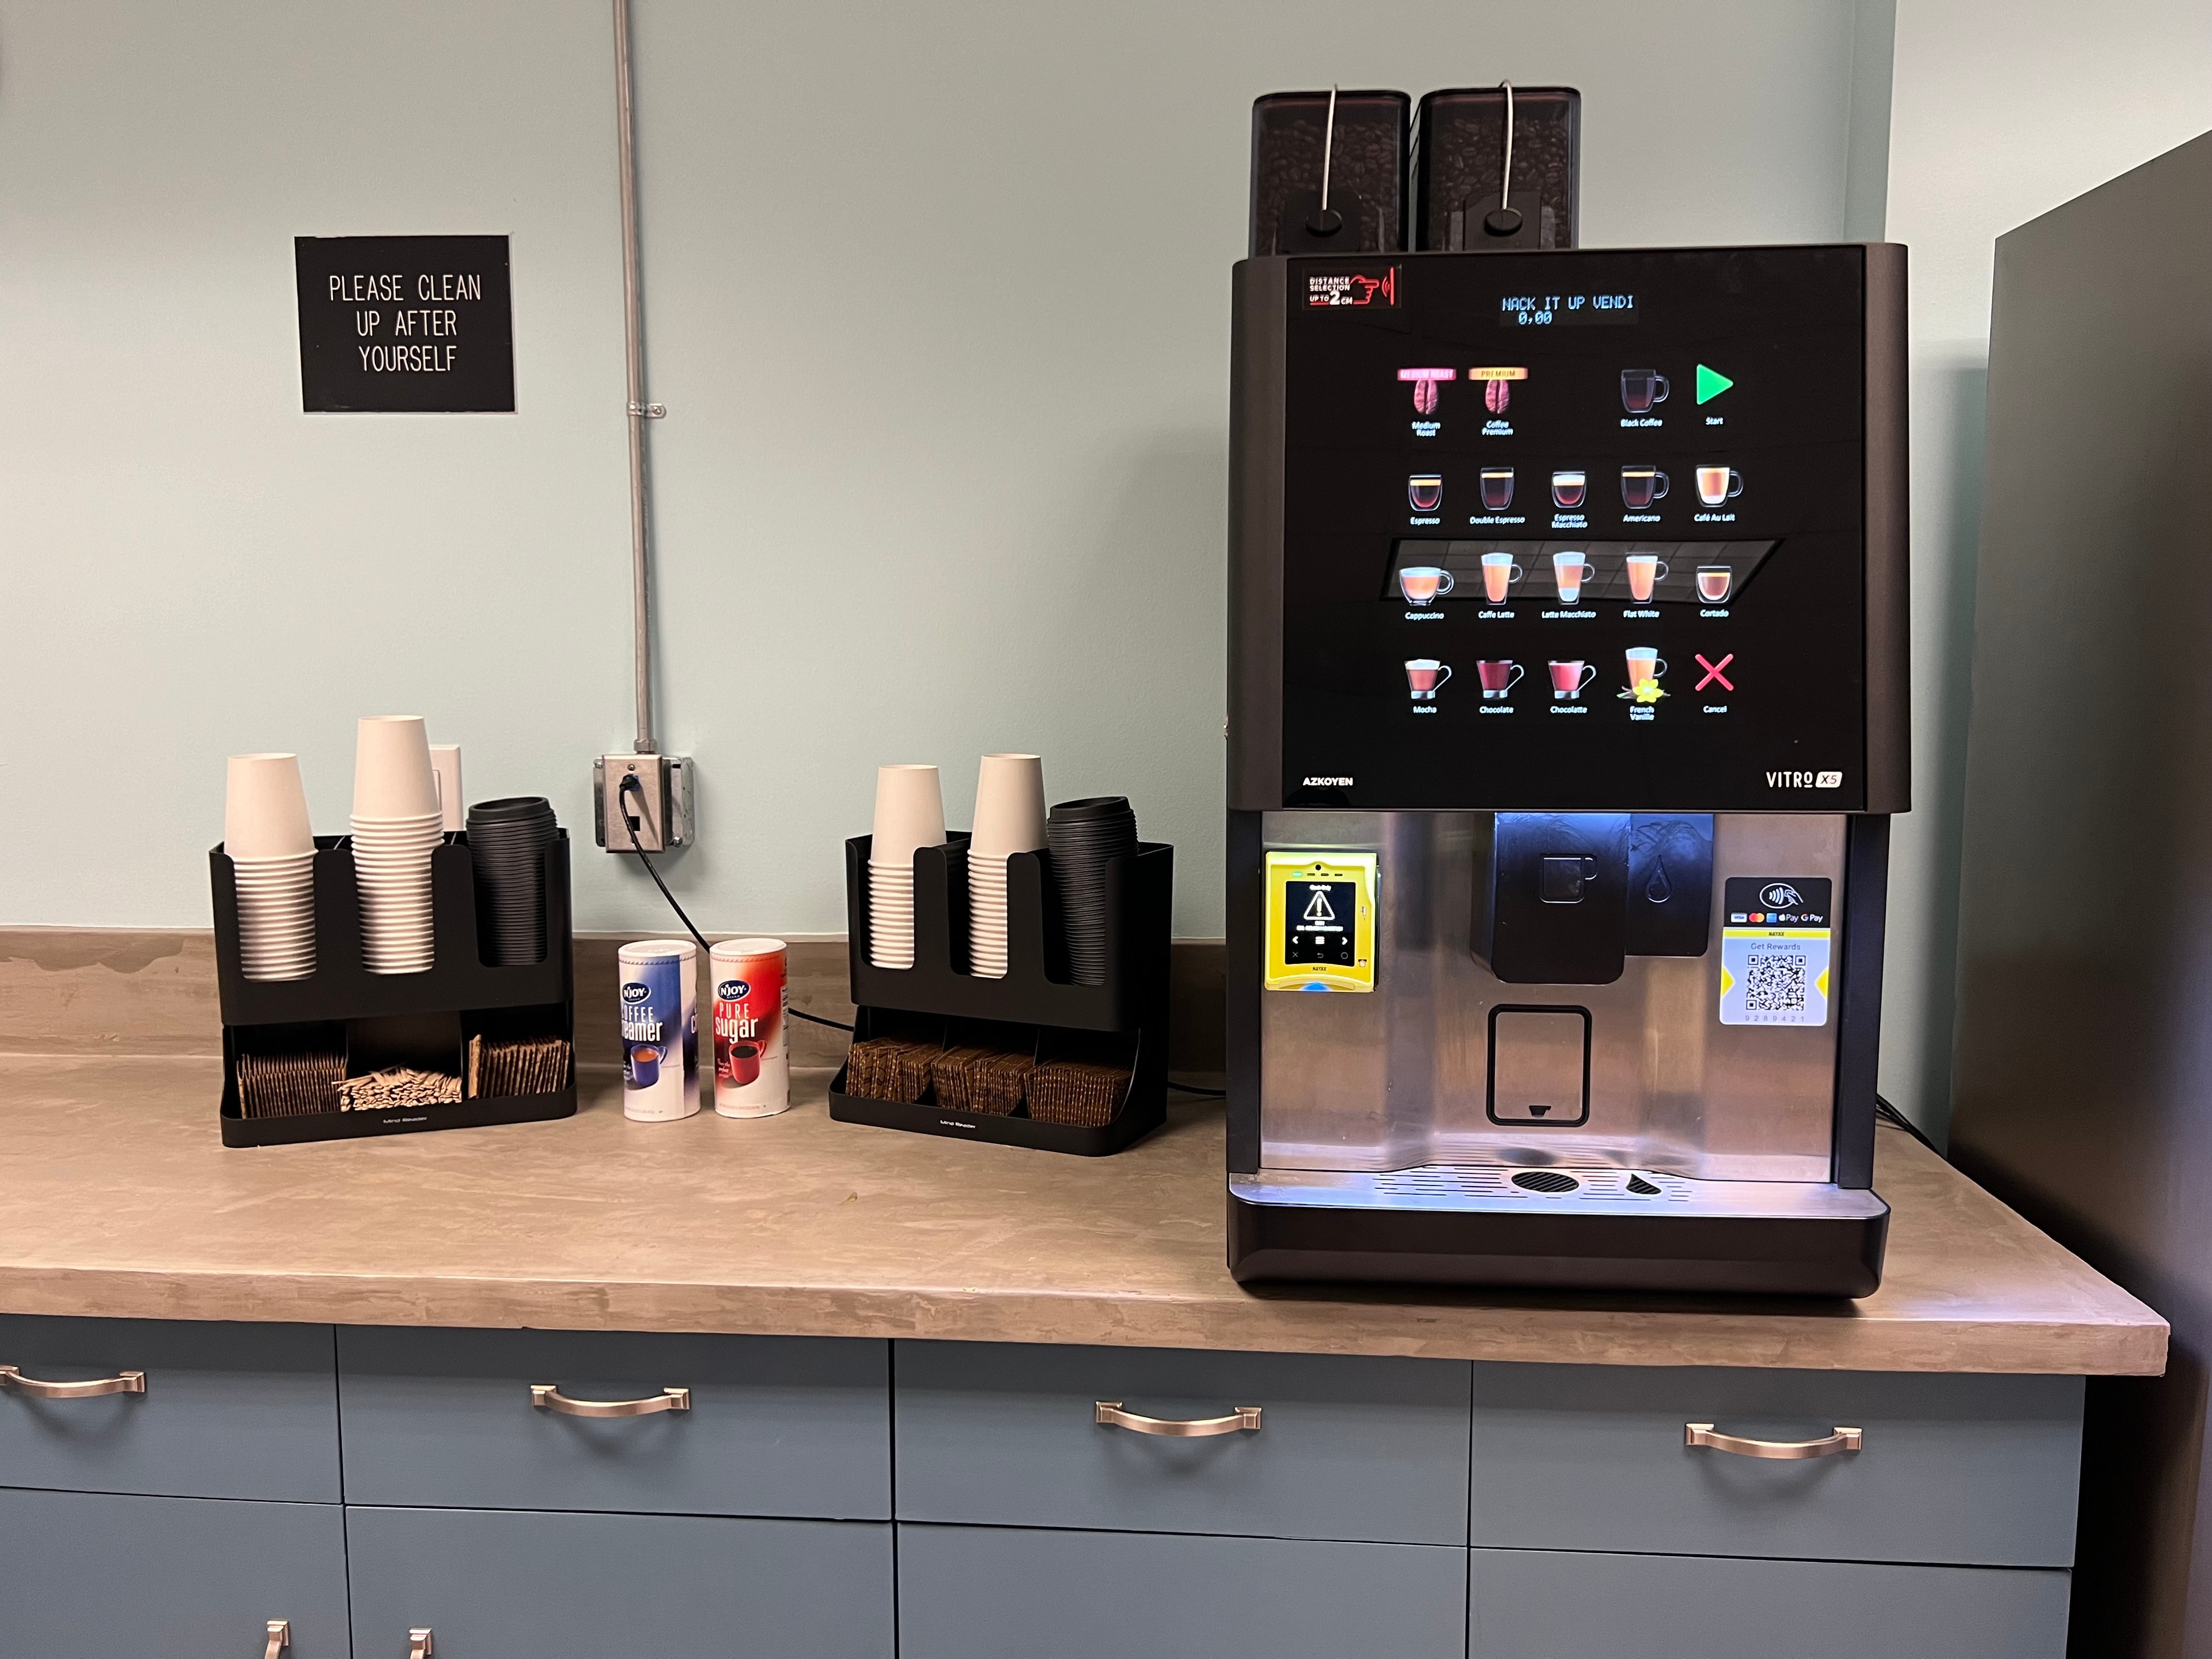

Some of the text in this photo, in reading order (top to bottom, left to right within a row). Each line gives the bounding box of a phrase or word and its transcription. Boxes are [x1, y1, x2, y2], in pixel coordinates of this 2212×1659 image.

[1309, 276, 1350, 285] DISTANCE
[329, 274, 481, 301] PLEASE CLEAN
[1330, 290, 1340, 305] 2
[1341, 297, 1353, 305] CM
[1502, 295, 1633, 311] NACK IT UP VENDI
[357, 310, 457, 336] UP AFTER
[358, 346, 457, 372] YOURSELF
[1400, 370, 1429, 379] MEDIUM
[1620, 418, 1663, 427] Black Coffee
[1706, 417, 1724, 425] Start
[1412, 422, 1441, 430] Medium
[1482, 427, 1513, 435] Premium
[1410, 517, 1440, 526] Espresso
[1469, 516, 1525, 526] Double Espresso
[1554, 514, 1585, 522] Espresso
[1623, 514, 1661, 522] Americano
[1551, 521, 1588, 529] Macchiato
[1405, 612, 1444, 621] Cappuccino
[1497, 611, 1514, 619] Latte
[1560, 611, 1596, 619] Macchiato
[1623, 610, 1660, 618] Flat White
[1700, 609, 1729, 618] Cortado
[1630, 706, 1655, 714] French
[1703, 705, 1727, 713] Cancel
[1302, 777, 1353, 786] AZKOYEN
[1766, 771, 1838, 788] VITRO X5
[1786, 914, 1799, 923] Pay
[1809, 914, 1823, 923] Pay
[719, 1002, 749, 1019] PURE
